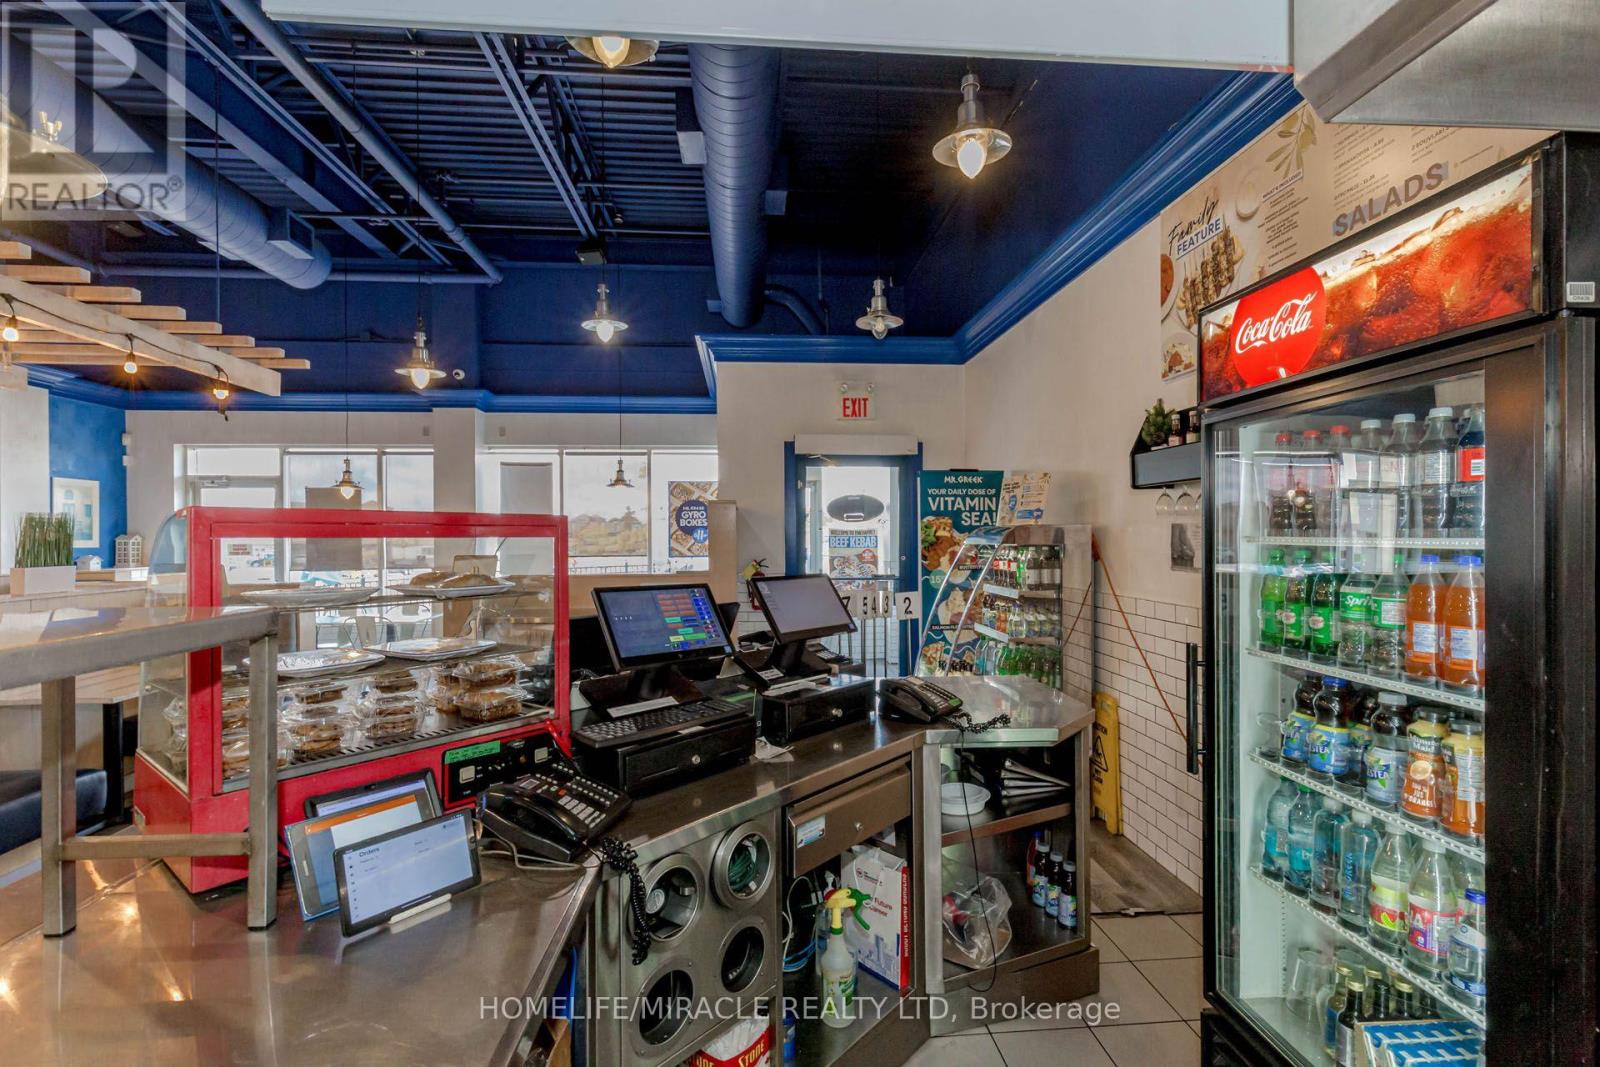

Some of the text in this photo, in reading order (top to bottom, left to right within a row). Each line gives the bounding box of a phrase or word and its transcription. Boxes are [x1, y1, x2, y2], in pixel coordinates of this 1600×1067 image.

[1334, 163, 1443, 236] SALADS
[1168, 197, 1219, 256] Family
[1177, 218, 1222, 255] FEATURE
[1235, 291, 1319, 354] Coca-Cola
[842, 397, 869, 418] EXIT
[928, 488, 997, 496] YOUR DAILY DOSE OF
[928, 497, 997, 511] VITAMIN
[682, 510, 706, 519] GYRO
[961, 512, 997, 526] SEA!
[829, 536, 877, 548] BEEF KEBAB
[863, 597, 868, 614] 5
[871, 594, 877, 613] 4
[884, 595, 889, 613] 3
[904, 596, 913, 614] 2
